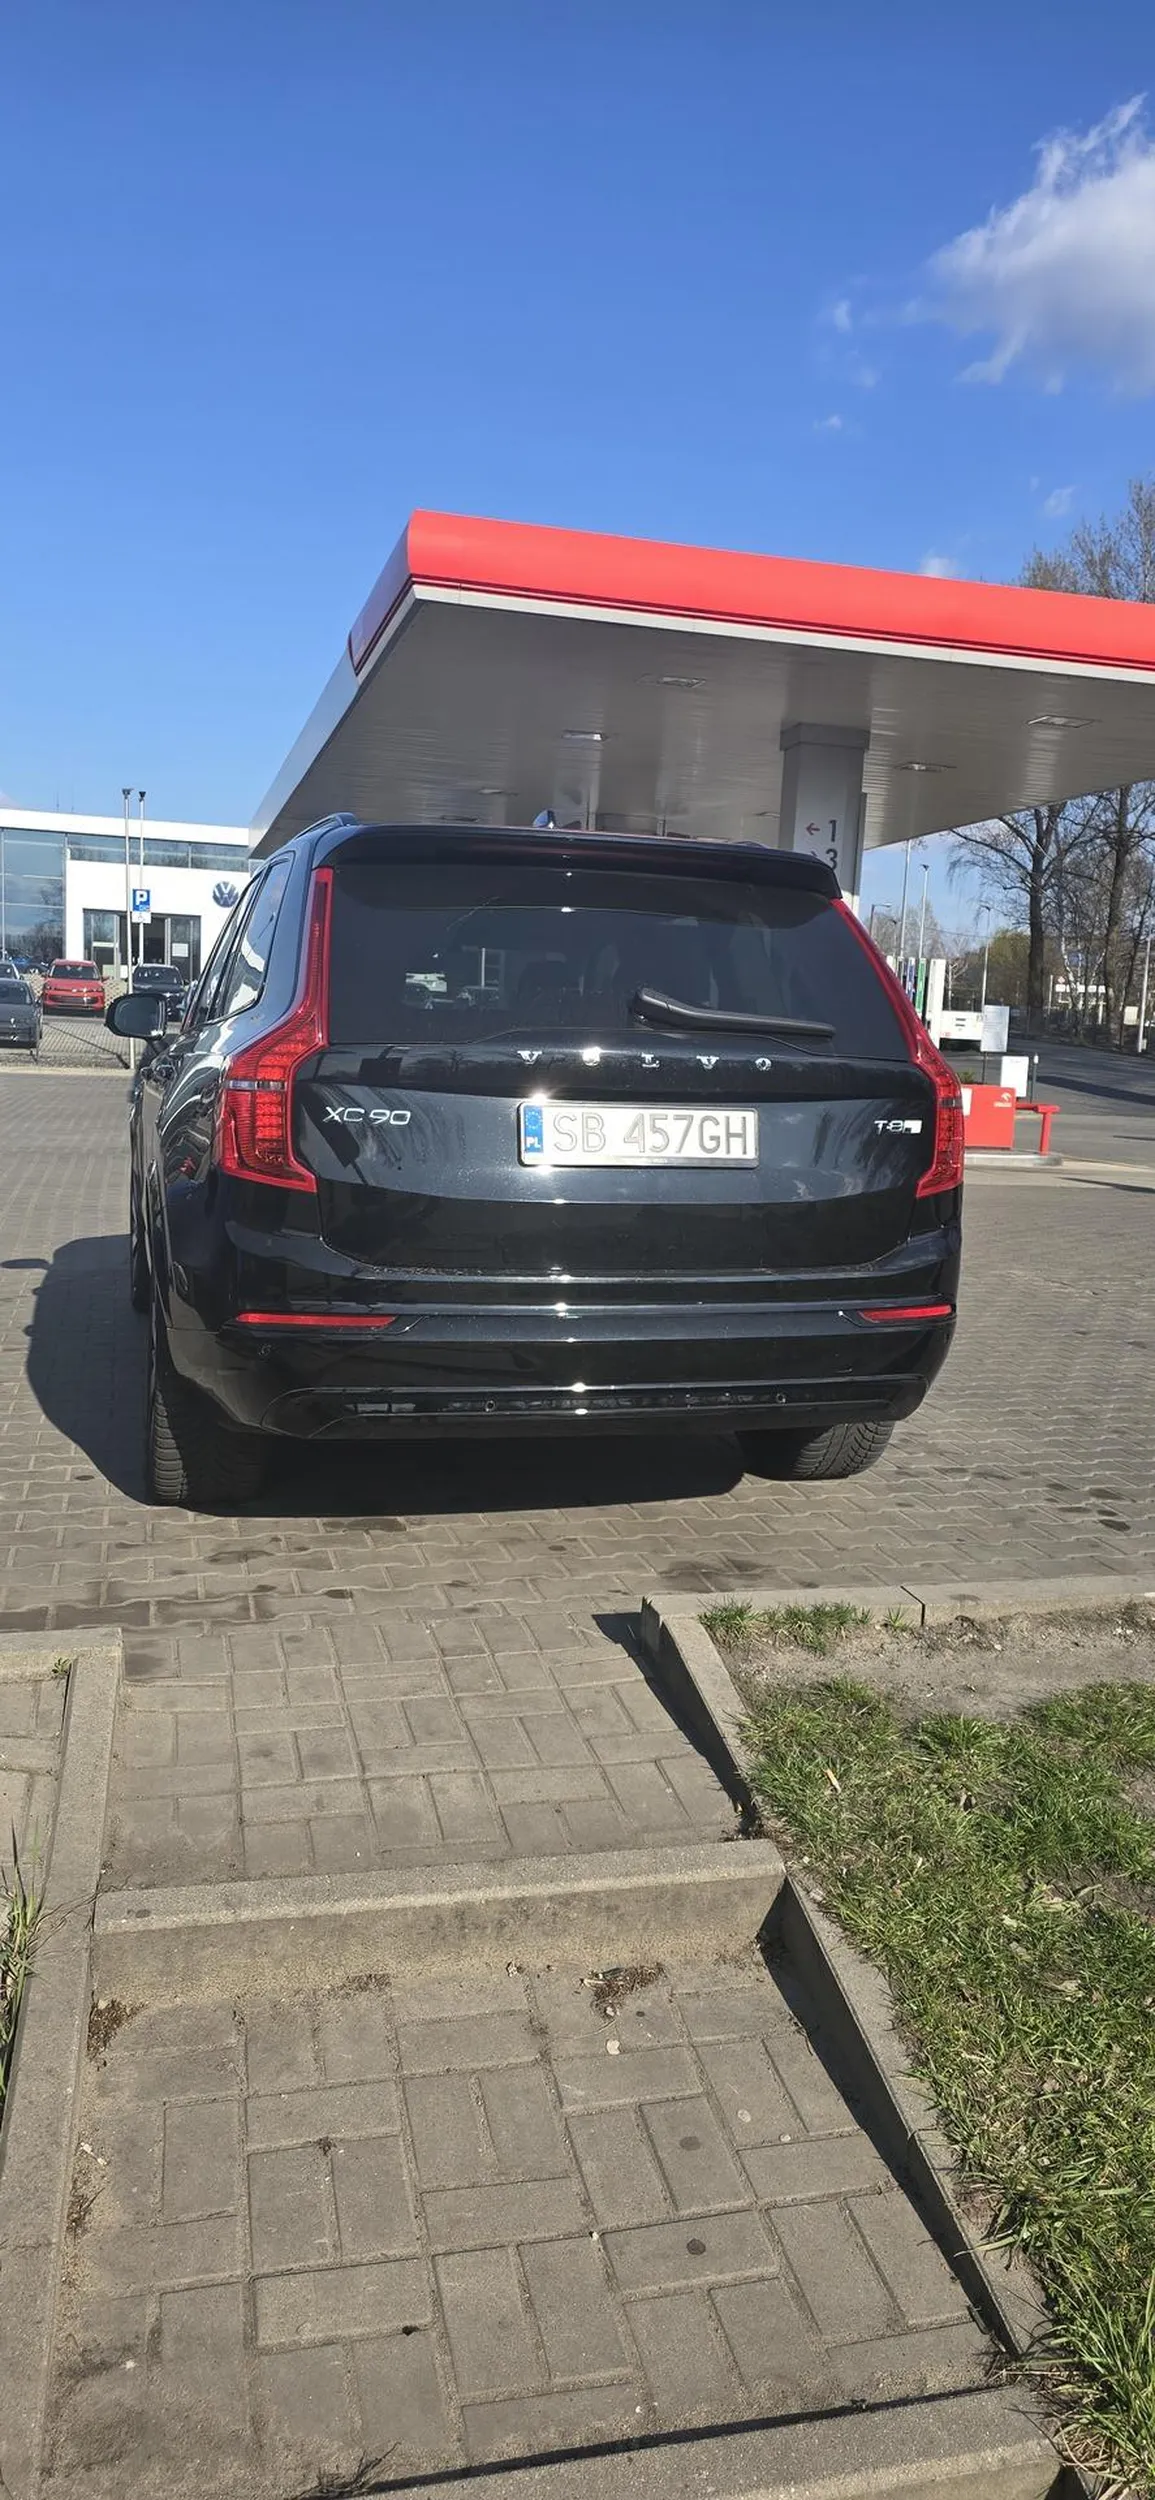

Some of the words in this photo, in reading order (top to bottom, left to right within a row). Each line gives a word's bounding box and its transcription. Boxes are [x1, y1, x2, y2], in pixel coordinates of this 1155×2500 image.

[828, 819, 837, 843] 1
[825, 848, 838, 871] 3
[135, 890, 148, 905] P
[517, 1047, 772, 1072] VOLVO
[553, 1111, 607, 1153] SB
[623, 1112, 748, 1156] 457GH
[874, 1120, 904, 1134] T8
[526, 1137, 541, 1149] PL
